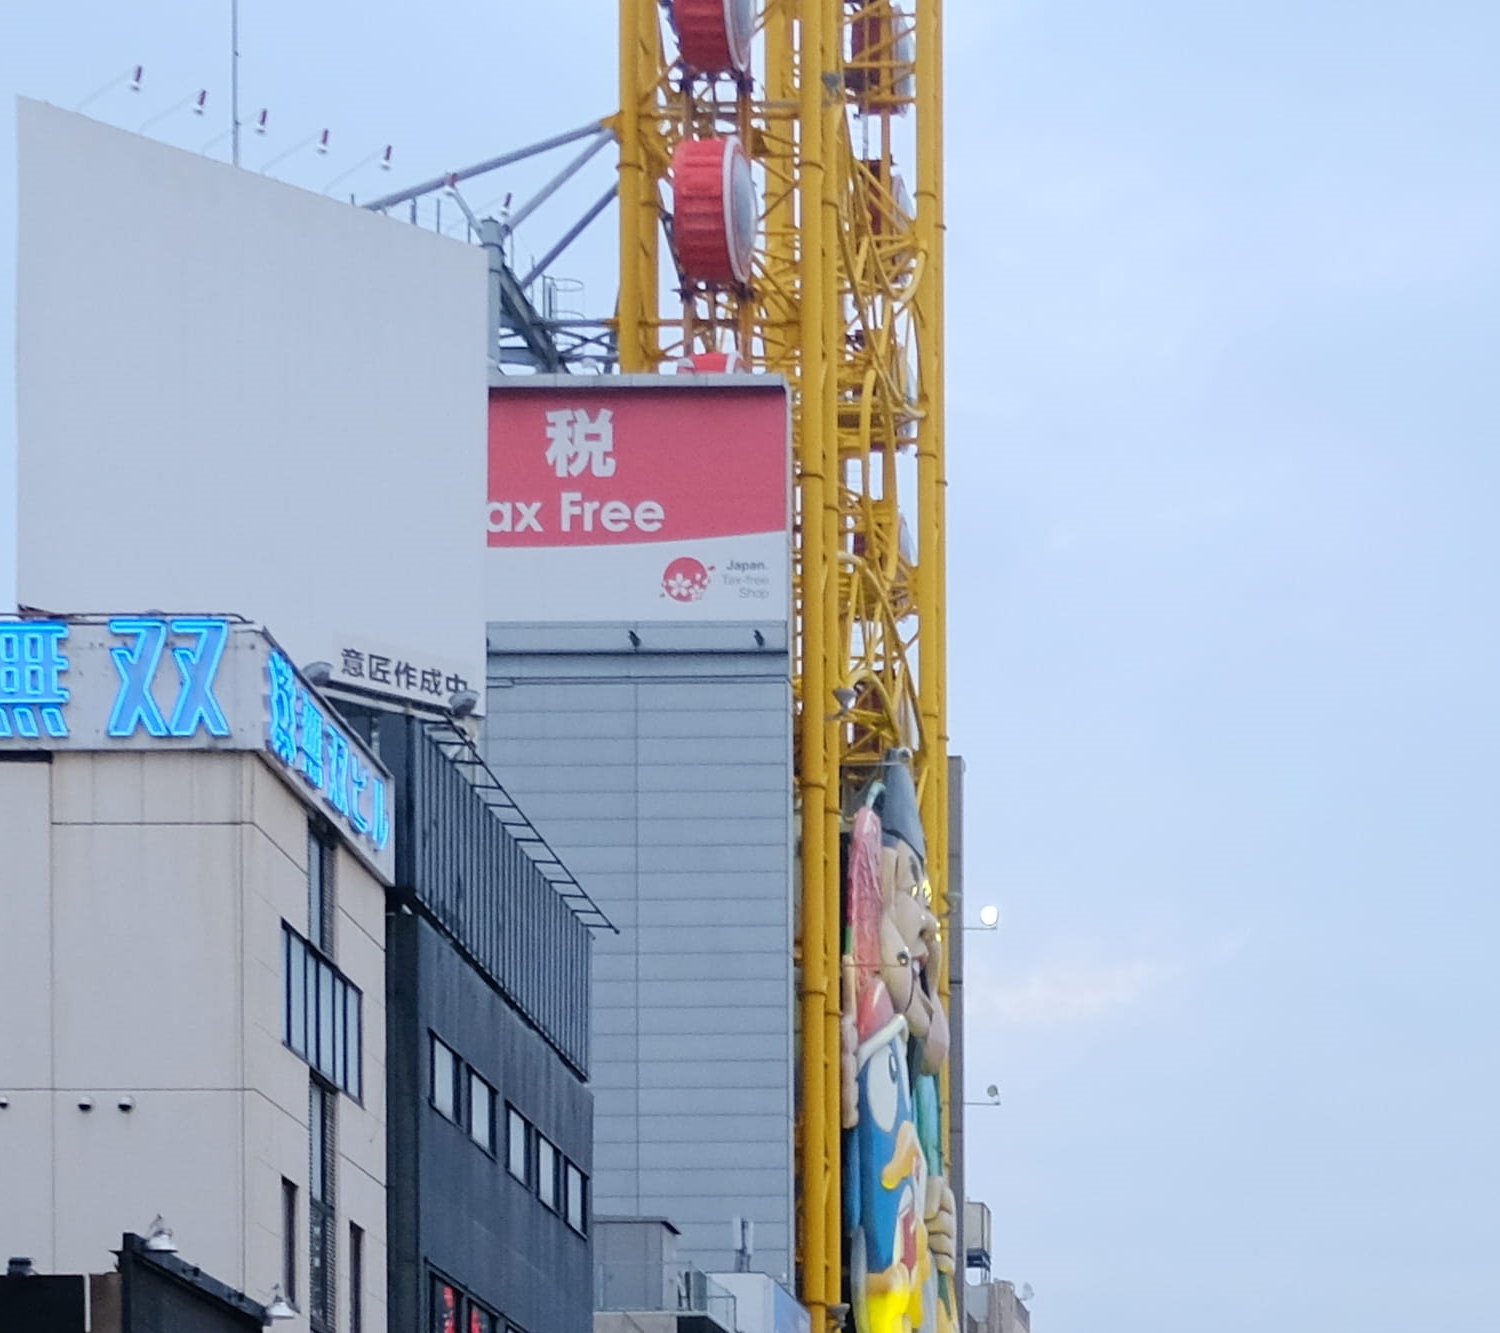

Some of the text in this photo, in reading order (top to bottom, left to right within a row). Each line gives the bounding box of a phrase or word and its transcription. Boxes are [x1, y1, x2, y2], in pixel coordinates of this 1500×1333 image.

[544, 407, 618, 478] 税
[560, 491, 665, 533] Free
[340, 647, 470, 700] 意匠作成中
